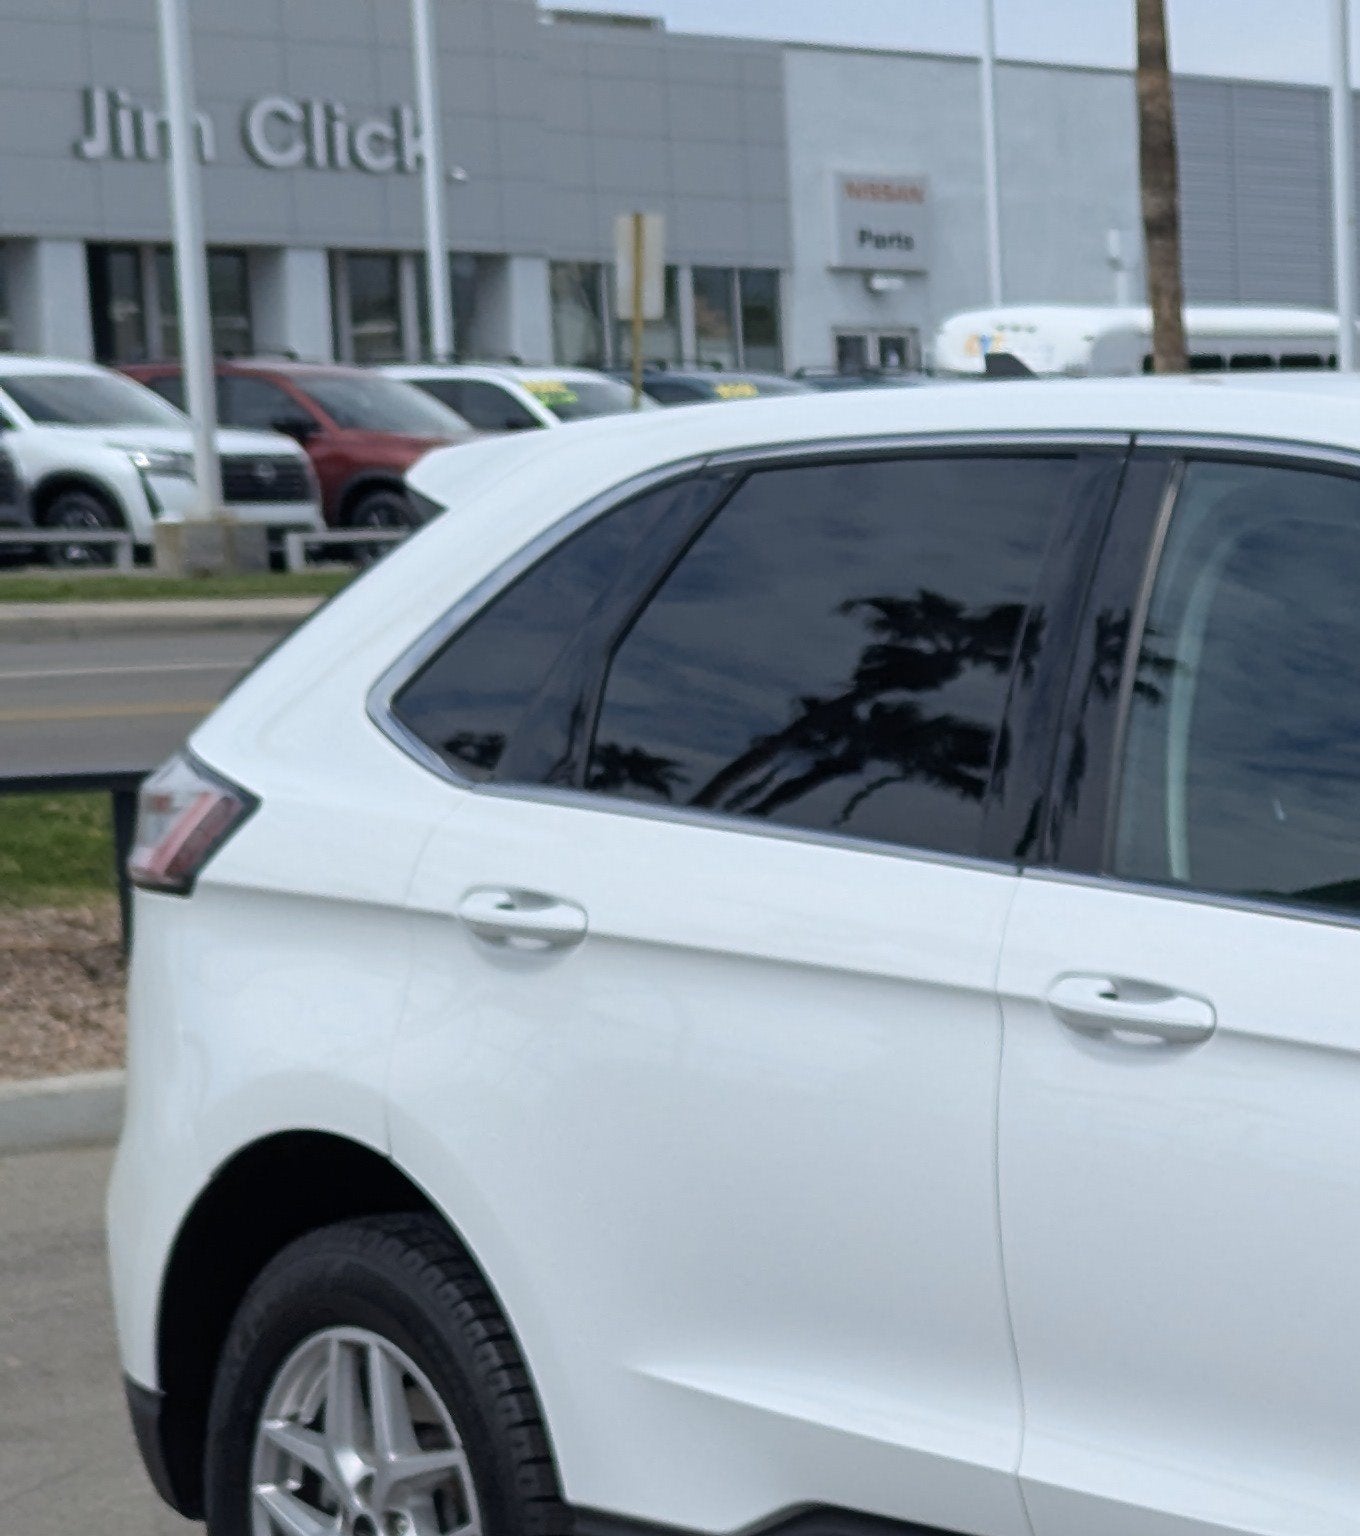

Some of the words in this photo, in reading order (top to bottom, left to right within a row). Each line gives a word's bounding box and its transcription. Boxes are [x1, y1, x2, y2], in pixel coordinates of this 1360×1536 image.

[78, 87, 216, 161] Jim
[244, 97, 427, 173] Click
[859, 229, 914, 250] Parts
